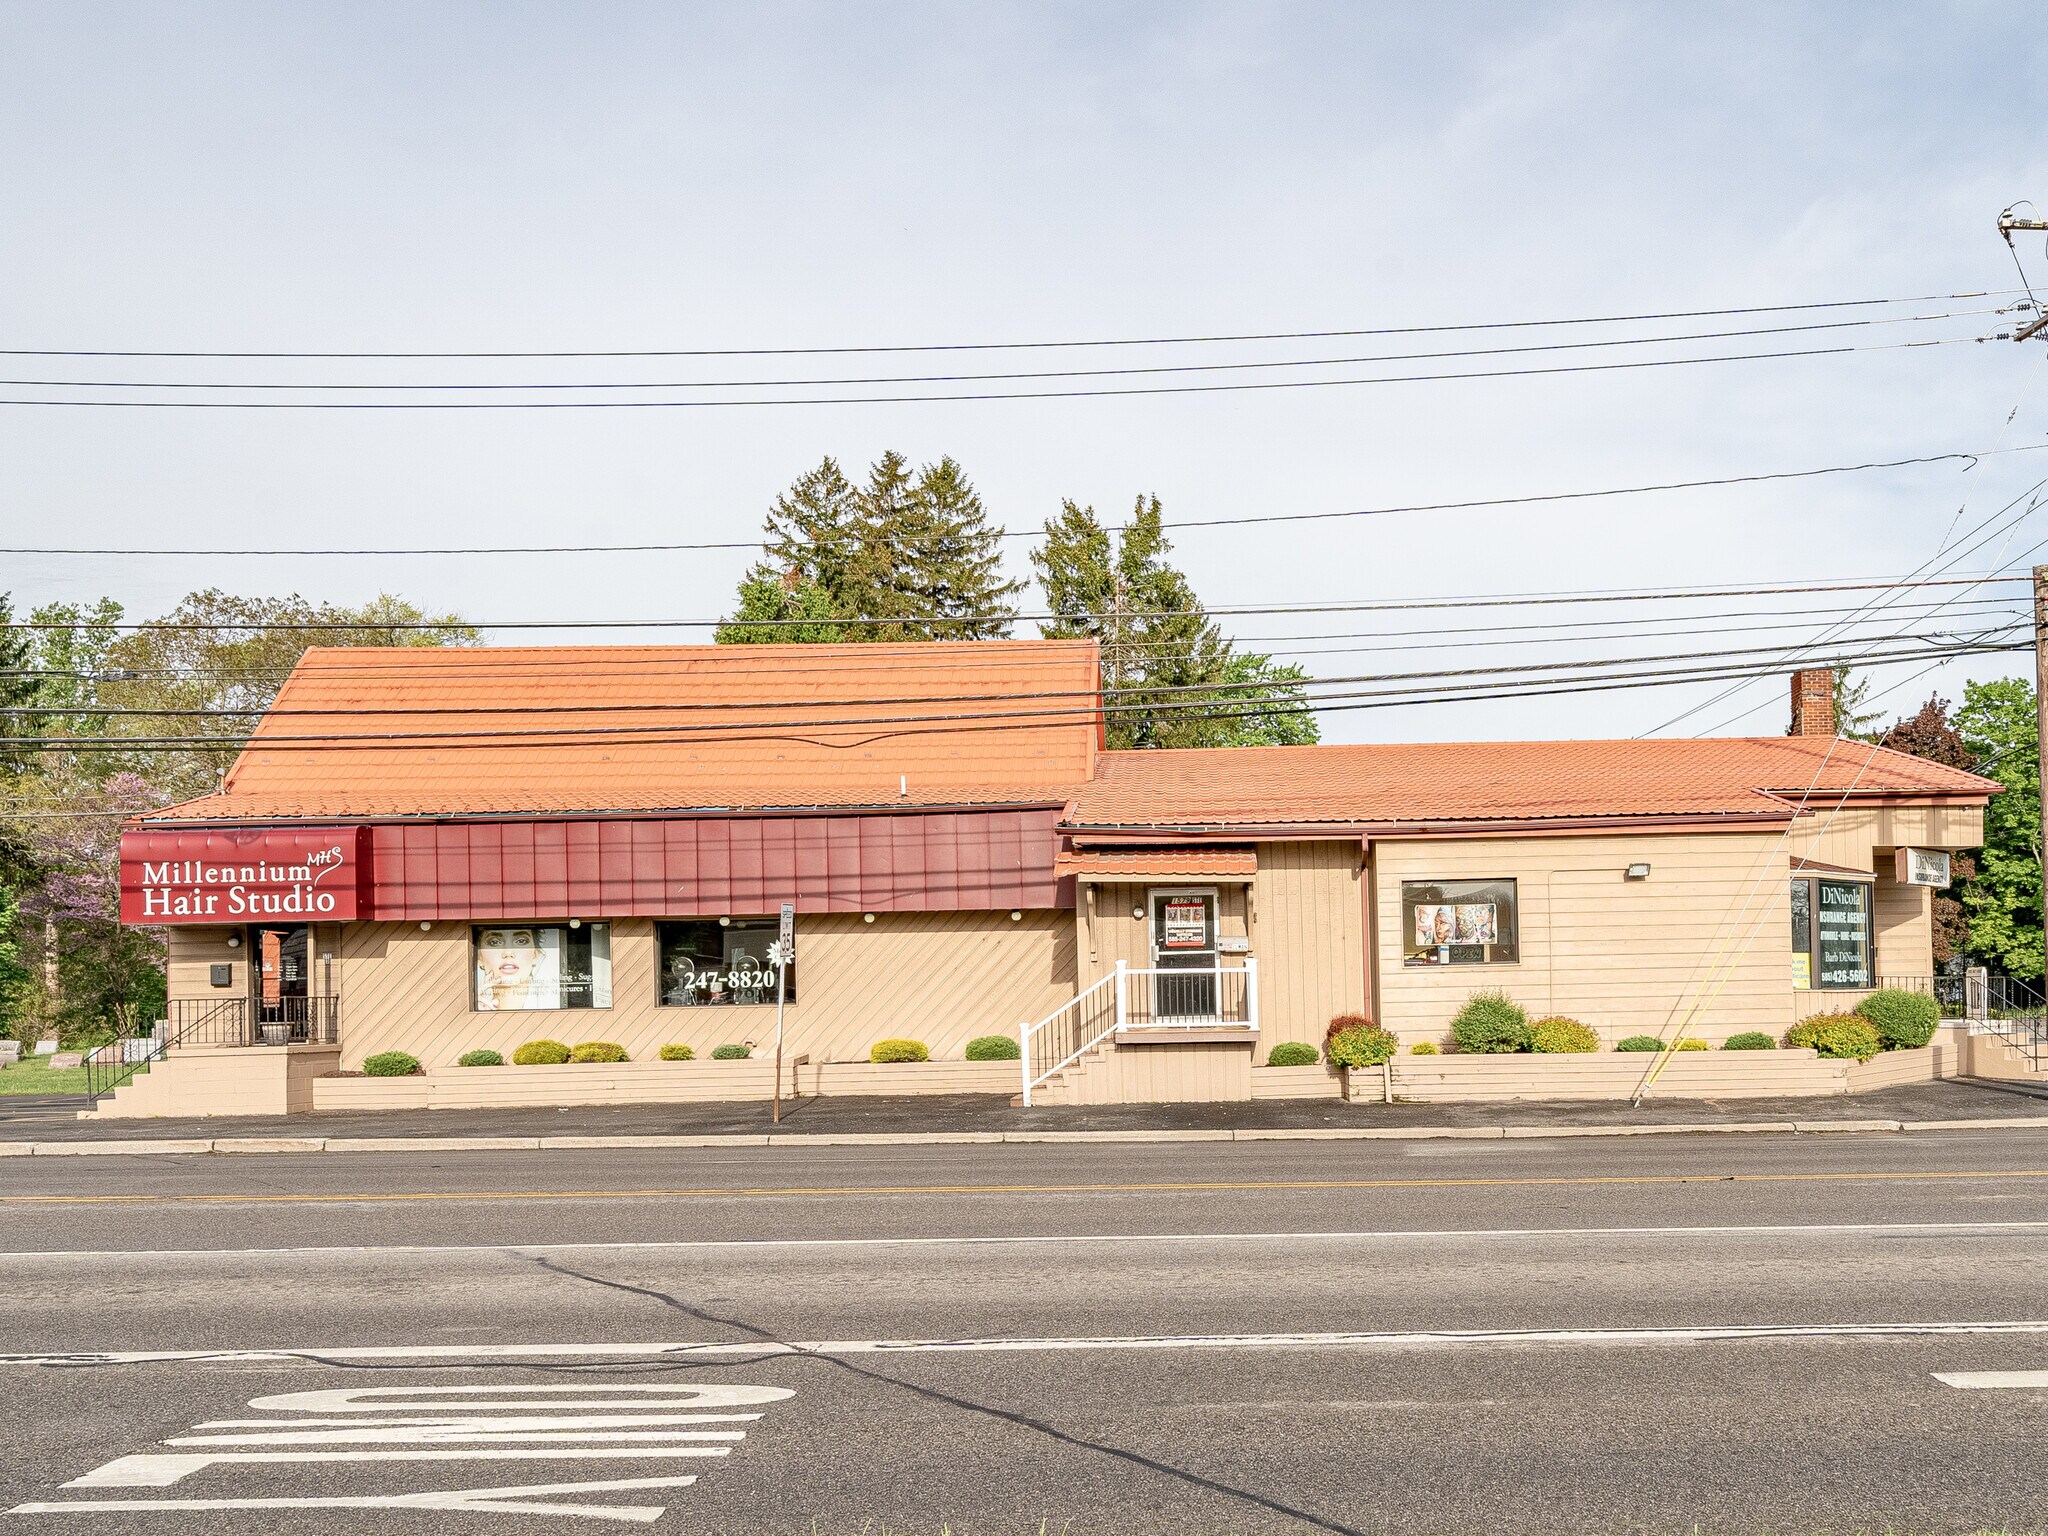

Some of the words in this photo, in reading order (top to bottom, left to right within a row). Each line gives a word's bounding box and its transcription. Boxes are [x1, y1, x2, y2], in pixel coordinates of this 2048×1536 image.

[1915, 855, 1944, 871] DiNicola
[142, 861, 312, 885] Millennium
[143, 887, 219, 916] Hair
[228, 884, 336, 914] Studio
[1822, 886, 1860, 905] DiNicola
[1820, 911, 1846, 923] NSURANCE
[781, 932, 791, 952] 35
[1452, 946, 1482, 959] OPEN
[1825, 951, 1838, 962] Barb
[1839, 951, 1862, 962] DiNicola
[684, 970, 775, 990] 247-8820
[1832, 970, 1868, 983] 426-5602
